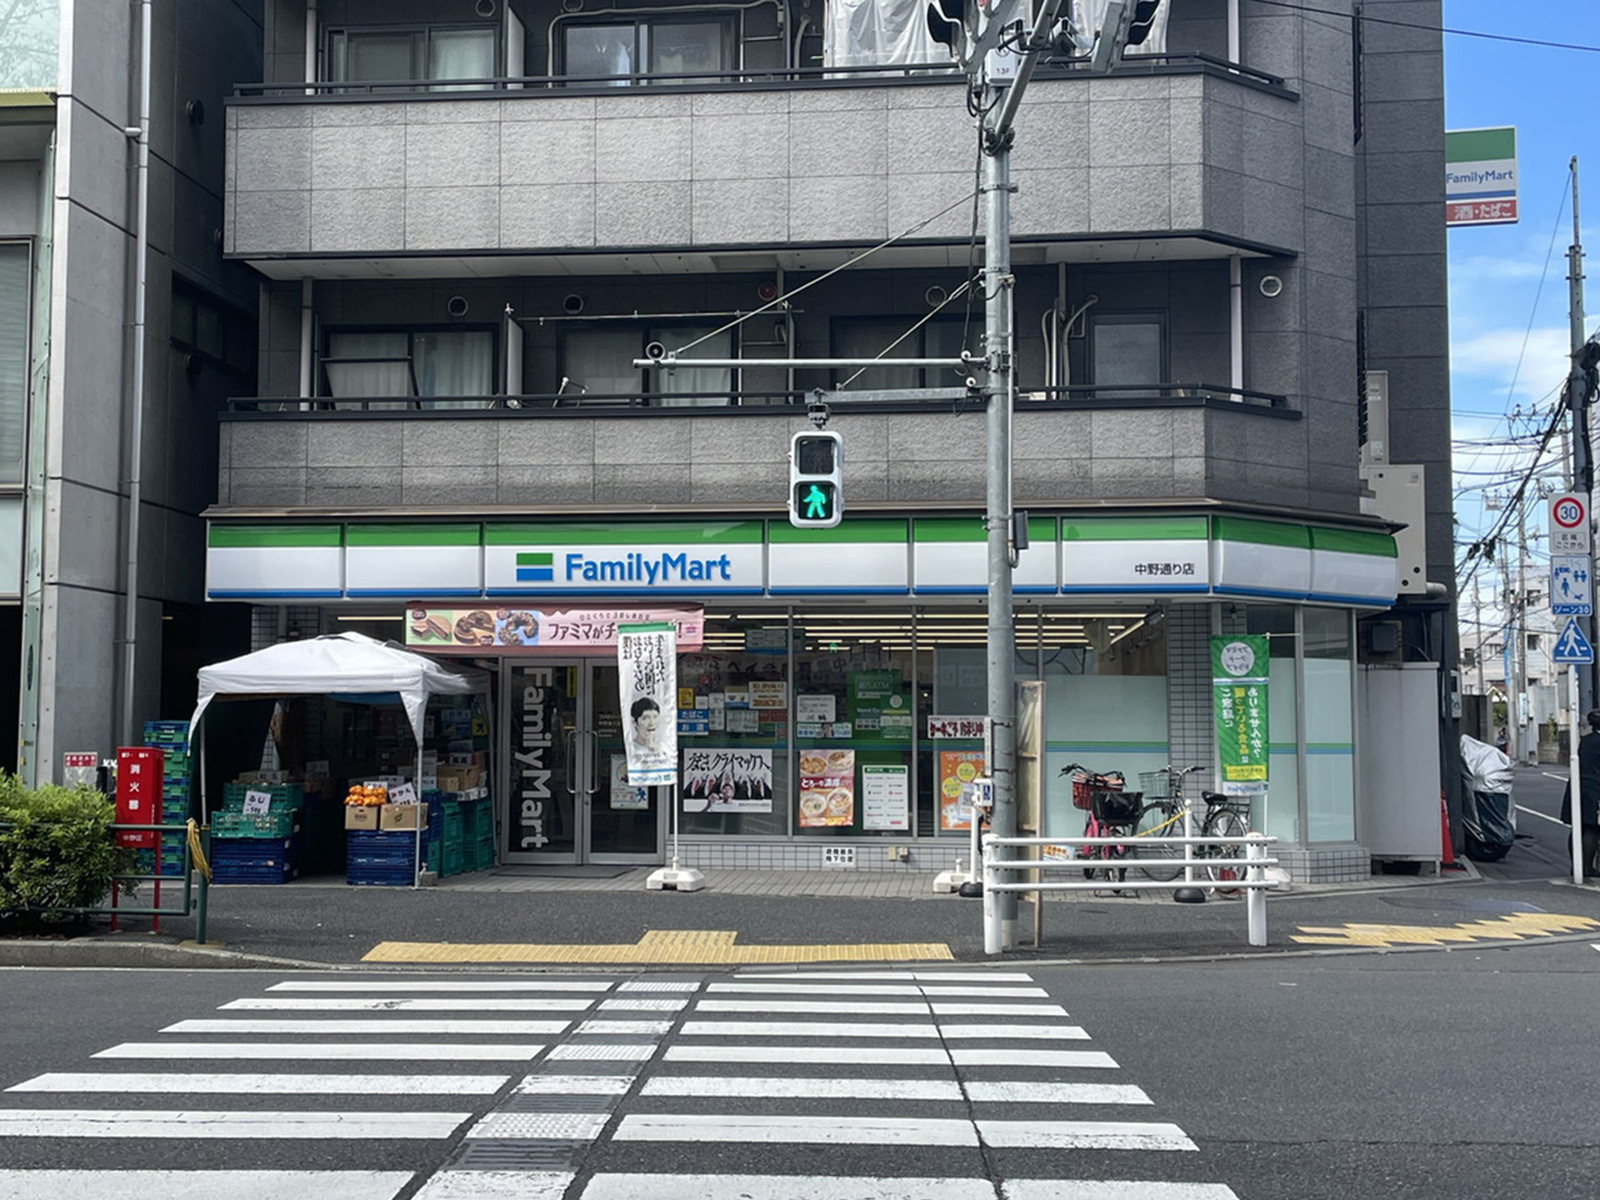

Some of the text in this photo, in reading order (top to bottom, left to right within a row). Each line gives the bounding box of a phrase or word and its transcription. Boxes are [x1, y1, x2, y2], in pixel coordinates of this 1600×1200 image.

[1446, 170, 1514, 184] FamilyMart
[1454, 203, 1512, 220] 酒・たばこ
[1560, 506, 1578, 520] 30
[1556, 541, 1585, 549] ここから
[566, 552, 732, 585] FamilyMart
[1134, 562, 1196, 576] 中野通り店
[1554, 605, 1590, 614] ゾーン30
[682, 710, 704, 719] たばこ
[514, 667, 553, 849] FamilyMart
[391, 787, 412, 799] みかん
